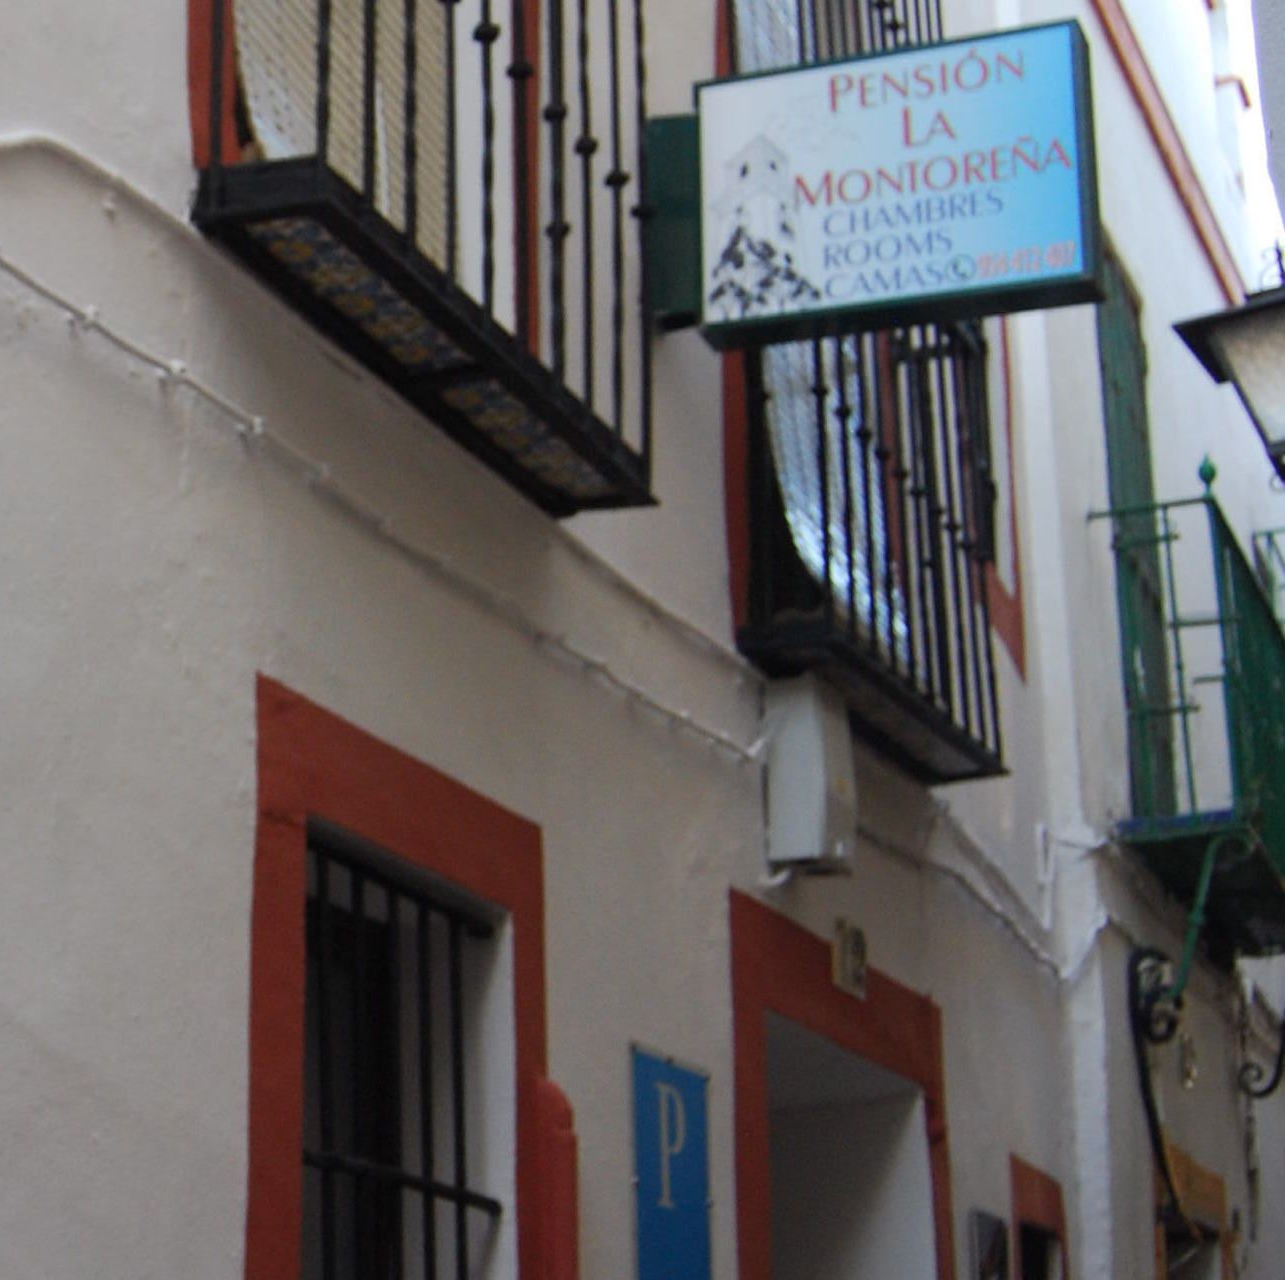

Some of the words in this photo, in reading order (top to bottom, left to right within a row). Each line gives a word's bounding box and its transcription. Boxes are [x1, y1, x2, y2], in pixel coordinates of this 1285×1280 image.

[827, 48, 1024, 113] PENSIÓN
[901, 106, 956, 149] LA
[793, 136, 1072, 209] MONTOREÑA
[822, 188, 1004, 237] CHAMBRES
[822, 229, 953, 270] ROOMS
[824, 259, 945, 300] CAMAS
[654, 1080, 686, 1209] P
